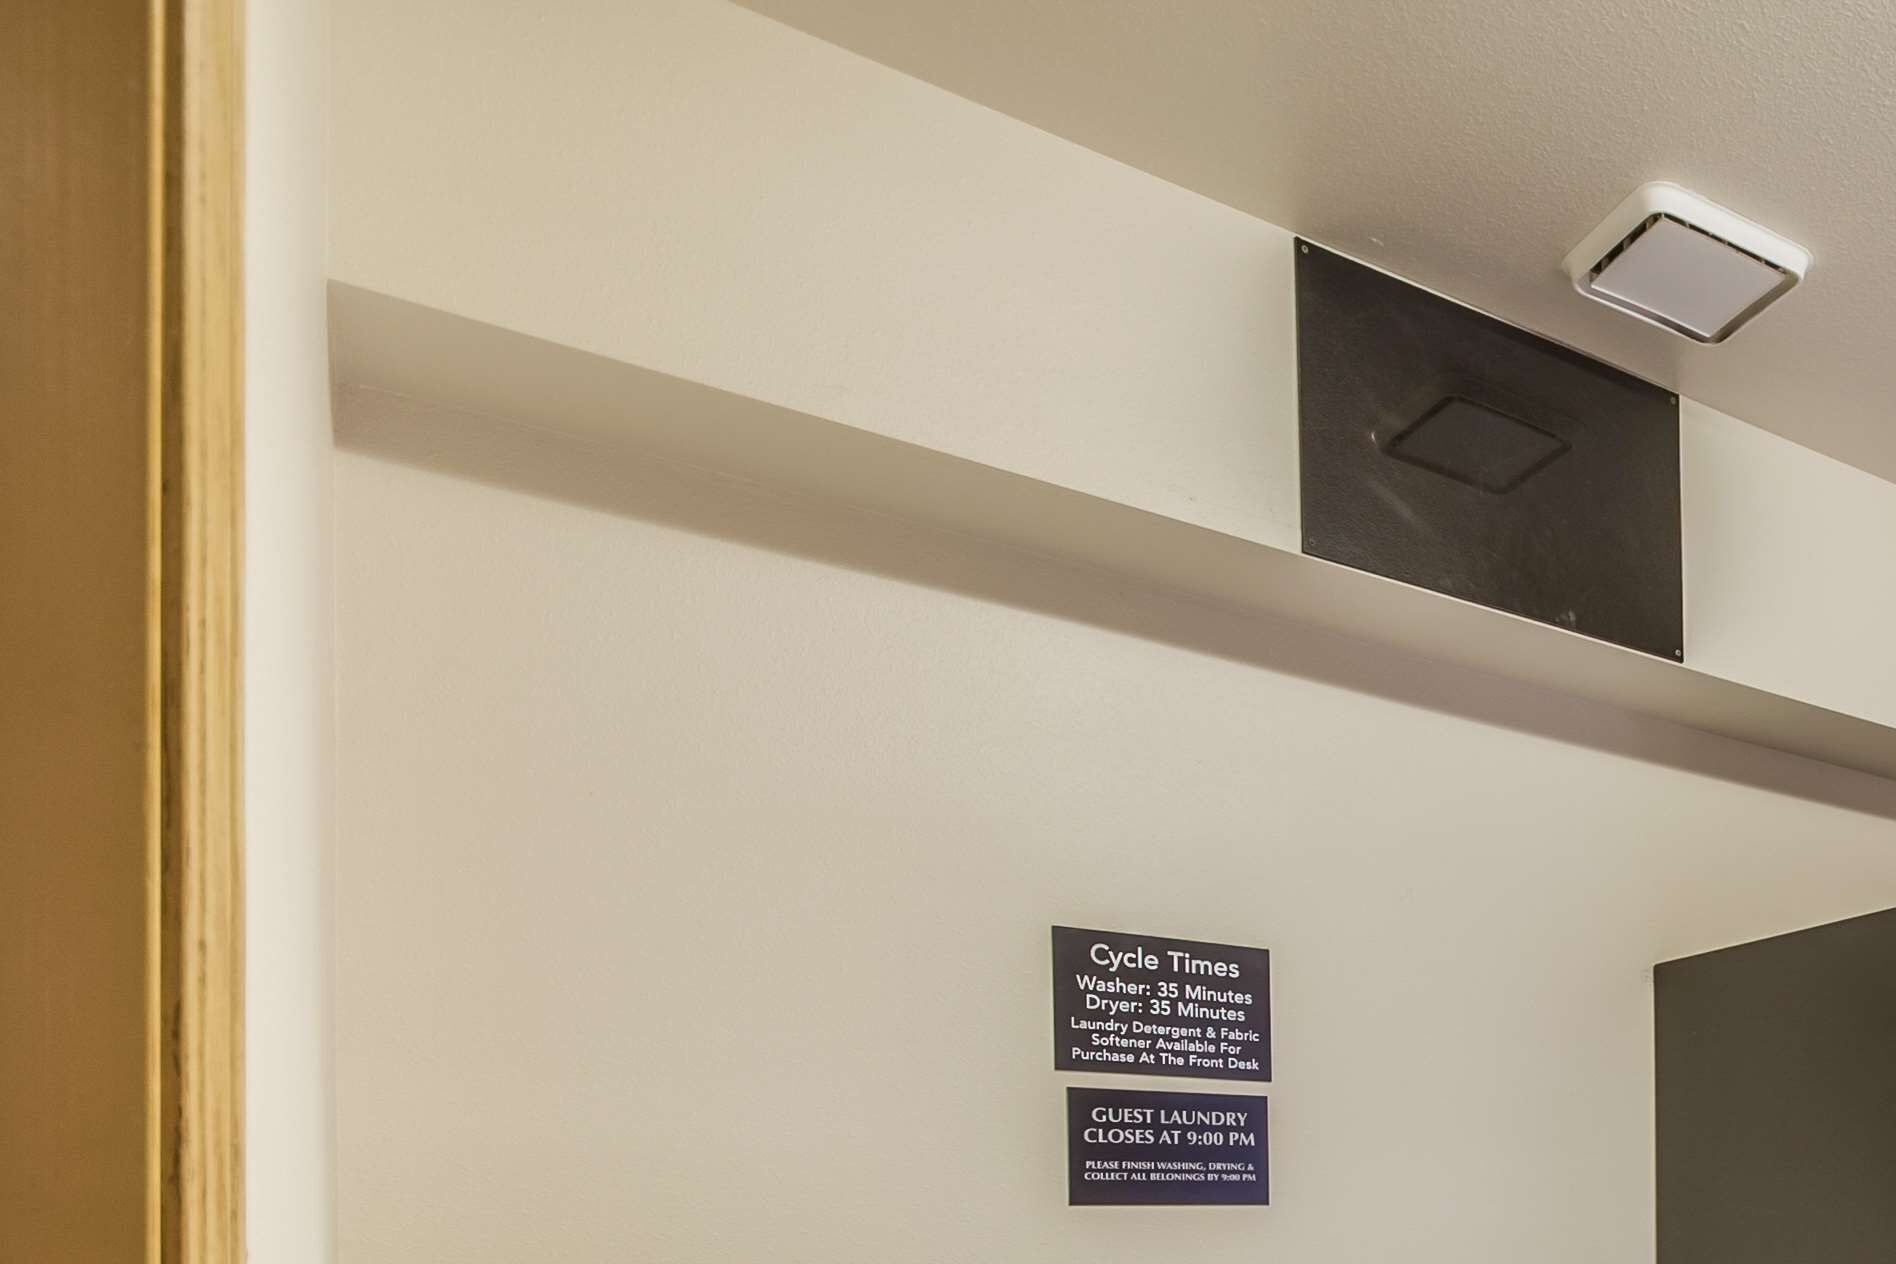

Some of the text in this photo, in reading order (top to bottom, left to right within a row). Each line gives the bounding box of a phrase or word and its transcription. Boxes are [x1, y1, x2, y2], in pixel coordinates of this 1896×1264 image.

[1090, 943, 1240, 978] Cycle Times
[1076, 974, 1253, 1005] Washer: 35 Minutes
[1085, 994, 1246, 1022] Dryer: 35 Minutes
[1071, 1017, 1260, 1042] Laundry Detergent & Fabric
[1091, 1034, 1242, 1055] Softener Available For
[1071, 1048, 1260, 1070] Purchase At The Front Desk
[1091, 1107, 1248, 1126] GUEST LAUNDRY
[1083, 1128, 1255, 1147] CLOSES AT 9:00 PM
[1085, 1160, 1254, 1172] PLEASE FINISH WASHING, DRYING &
[1084, 1172, 1128, 1181] COLLECT
[1130, 1172, 1148, 1181] ALL
[1207, 1173, 1220, 1182] BY
[1221, 1173, 1241, 1182] 9:00
[1242, 1173, 1257, 1182] PM
